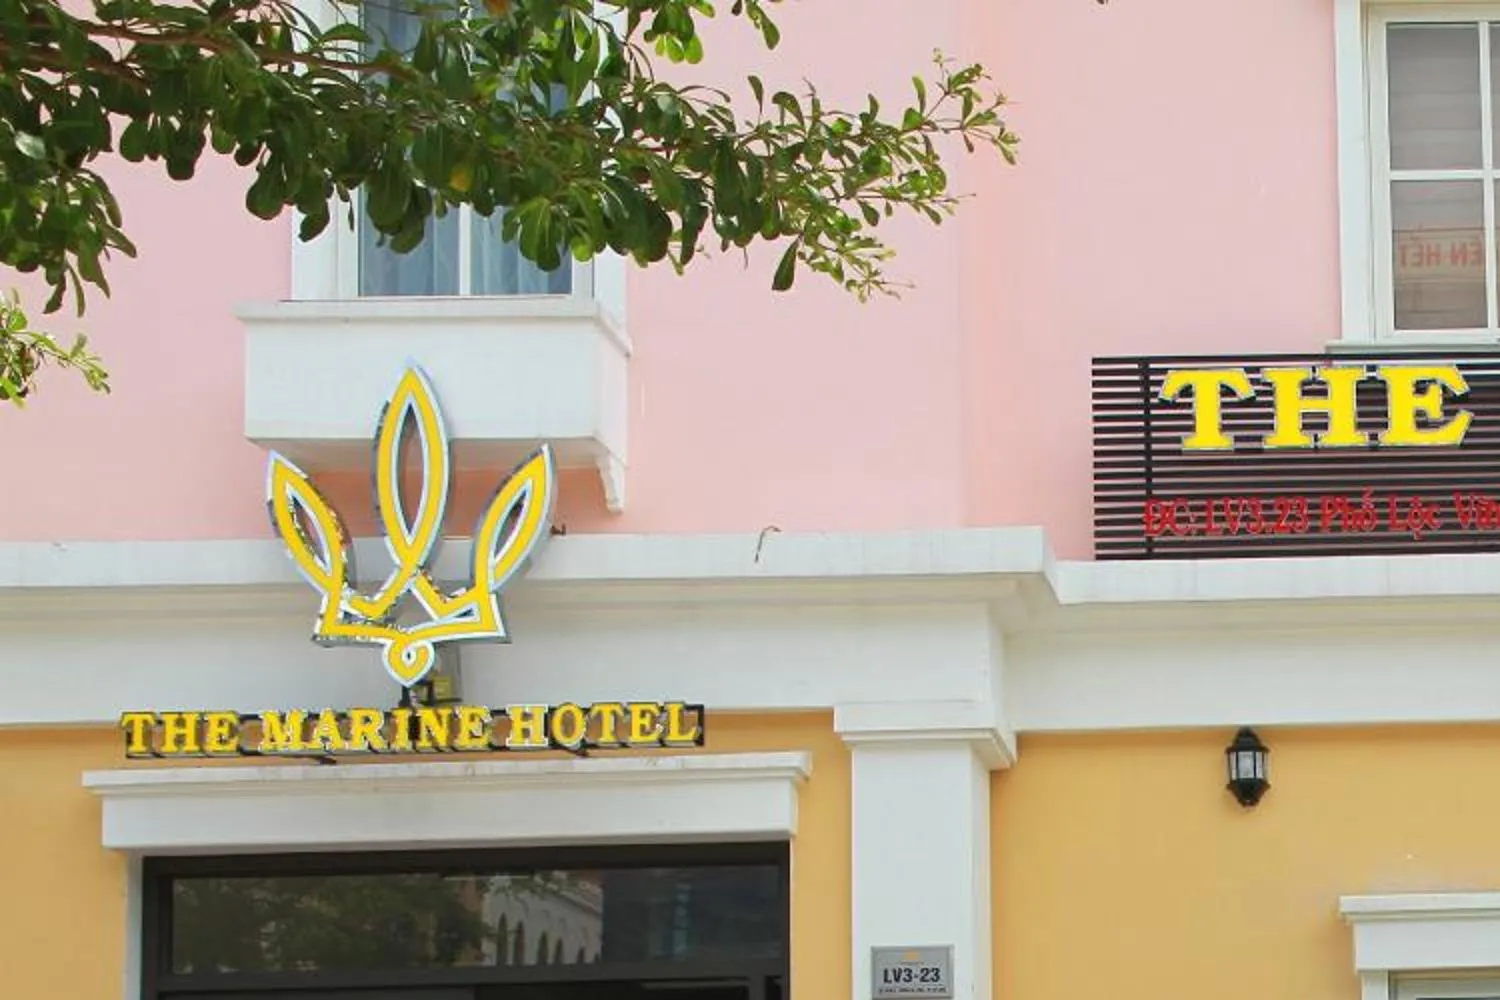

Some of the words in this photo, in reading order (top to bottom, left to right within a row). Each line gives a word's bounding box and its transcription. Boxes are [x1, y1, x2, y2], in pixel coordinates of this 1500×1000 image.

[1158, 364, 1475, 452] THE
[1320, 485, 1378, 533] Phố
[1388, 494, 1443, 541] Lộc
[121, 710, 240, 754] THE
[258, 706, 492, 754] MARINE
[505, 701, 698, 749] HOTEL
[883, 966, 941, 984] LV3-23
